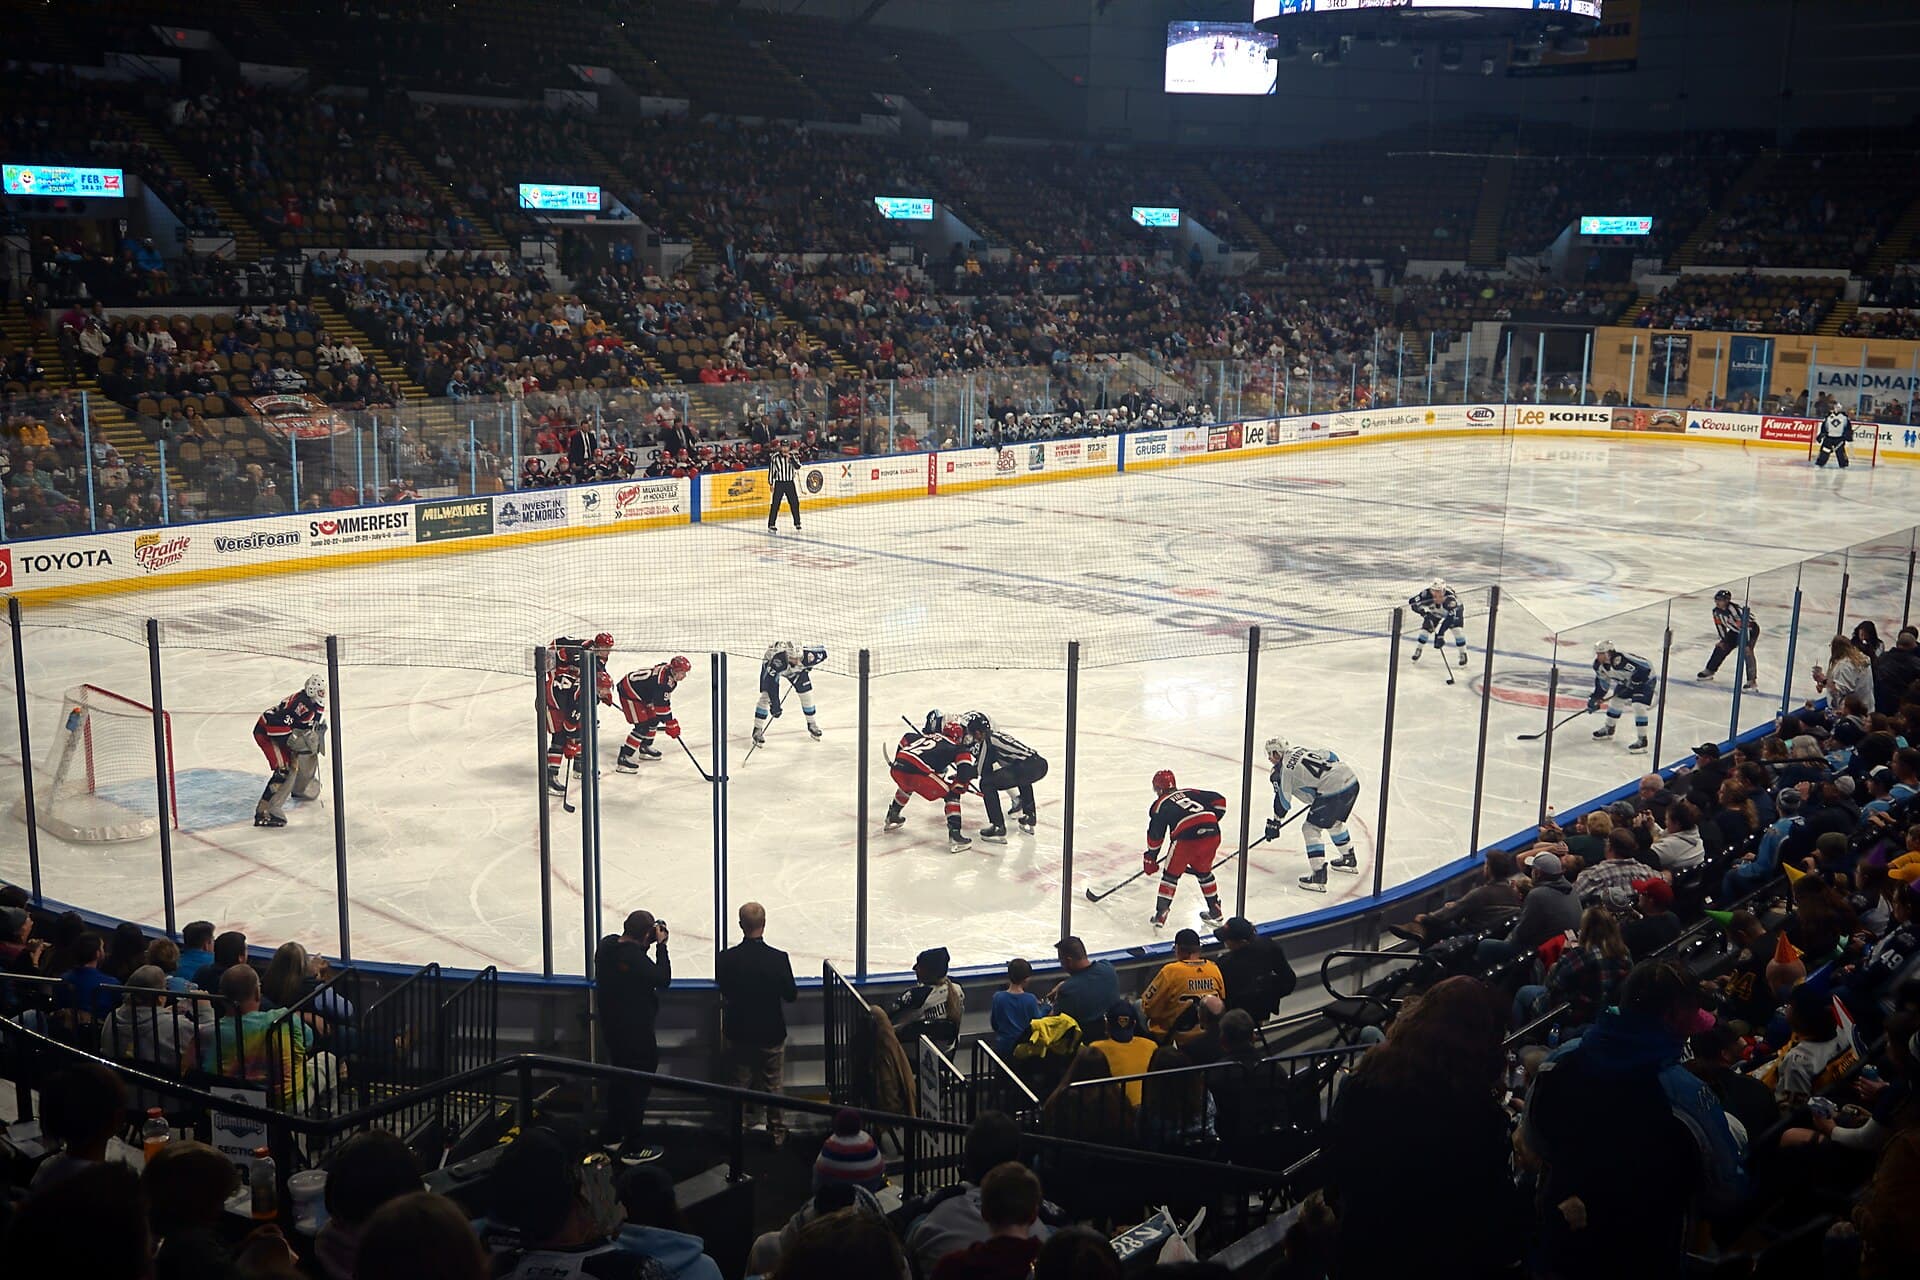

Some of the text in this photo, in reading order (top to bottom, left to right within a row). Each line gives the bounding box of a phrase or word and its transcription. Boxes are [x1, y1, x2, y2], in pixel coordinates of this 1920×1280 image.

[1517, 408, 1545, 425] Lee
[1549, 412, 1609, 423] KOHL'S
[1764, 418, 1793, 430] KWIK
[1702, 417, 1759, 433] Coors LIGHT
[1245, 425, 1264, 444] Lee
[1135, 443, 1167, 456] GRUBER
[421, 502, 488, 521] MILWAUKEE
[522, 499, 561, 511] INVEST IN
[522, 508, 565, 523] MEMORIES
[136, 536, 191, 563] Prairie
[215, 532, 300, 552] VersiFoam
[20, 549, 113, 574] TOYOTA
[145, 552, 183, 571] Farms
[1187, 978, 1215, 991] RINNE
[218, 1145, 257, 1157] SECTIO
